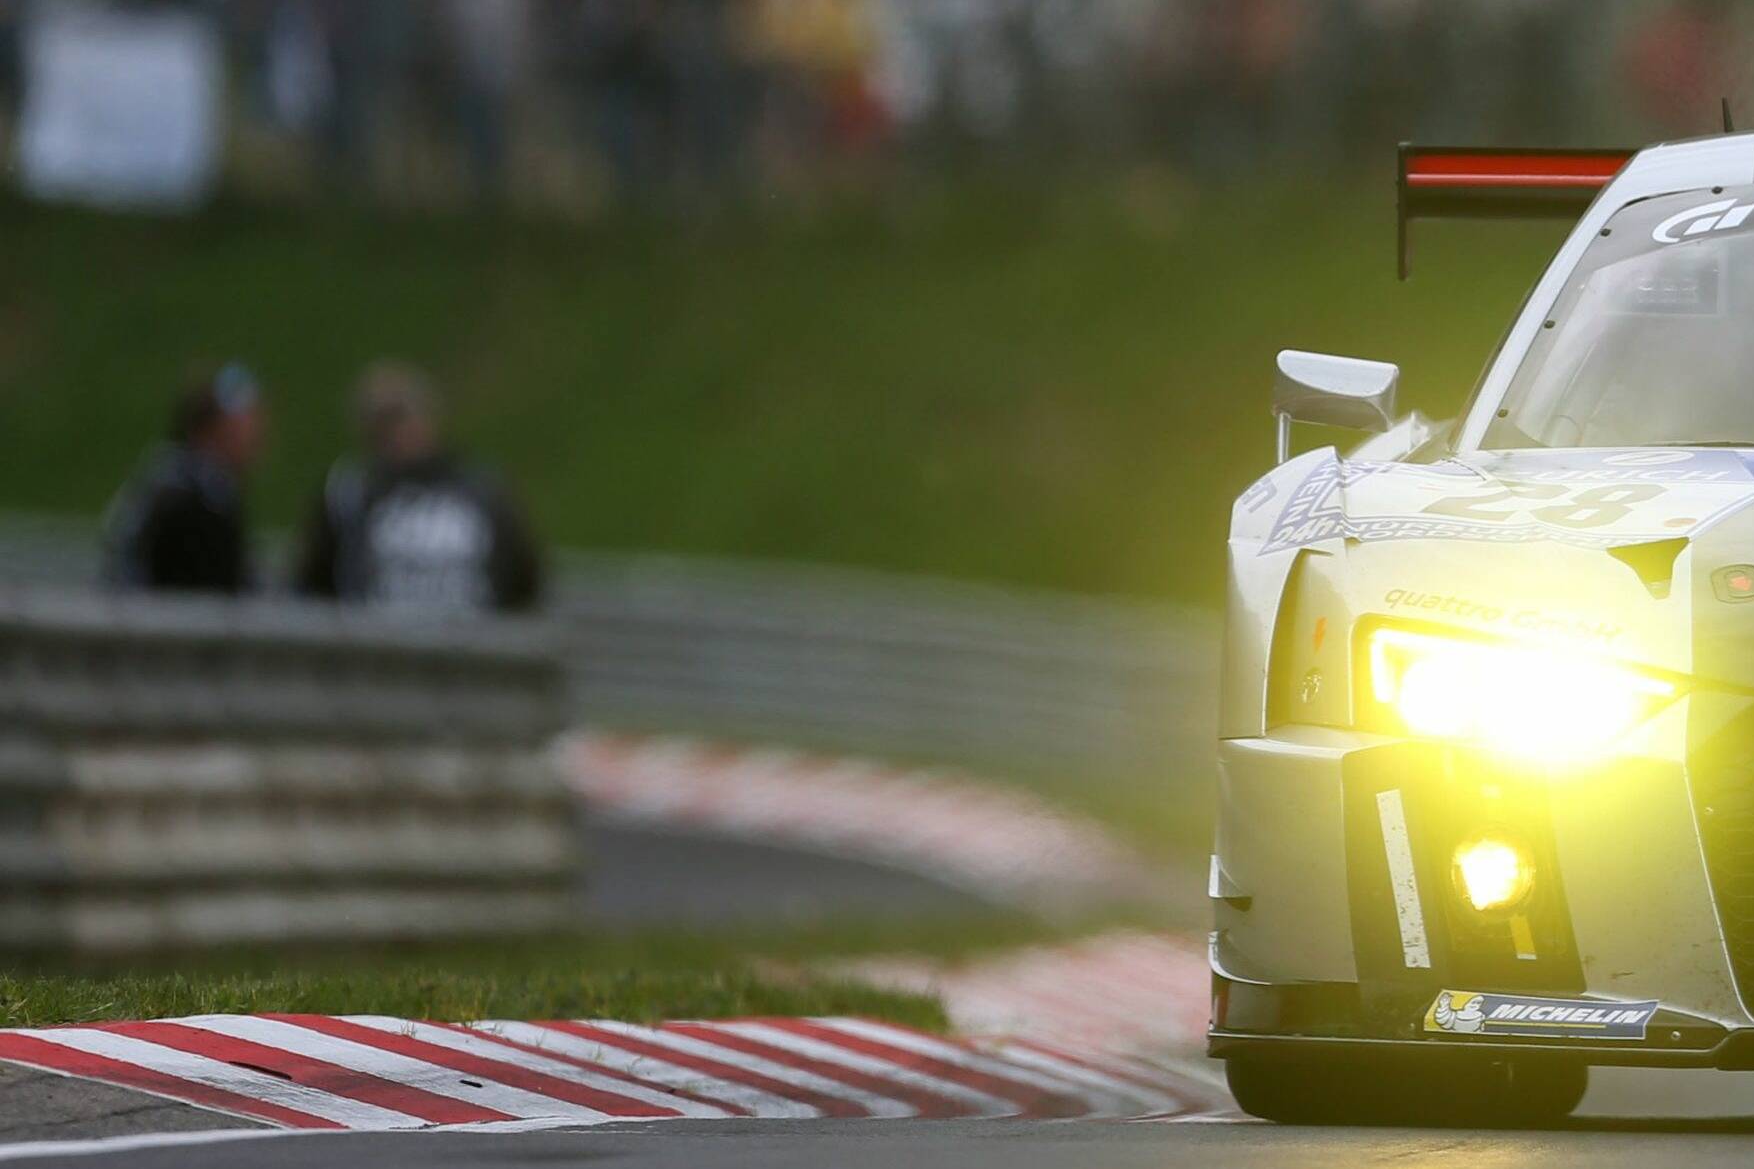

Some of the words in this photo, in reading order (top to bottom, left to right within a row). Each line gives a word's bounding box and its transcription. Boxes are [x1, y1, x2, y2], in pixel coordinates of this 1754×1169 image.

[1421, 480, 1667, 529] 28
[1383, 587, 1503, 623] quattro
[1492, 1004, 1648, 1024] MICHELIN
